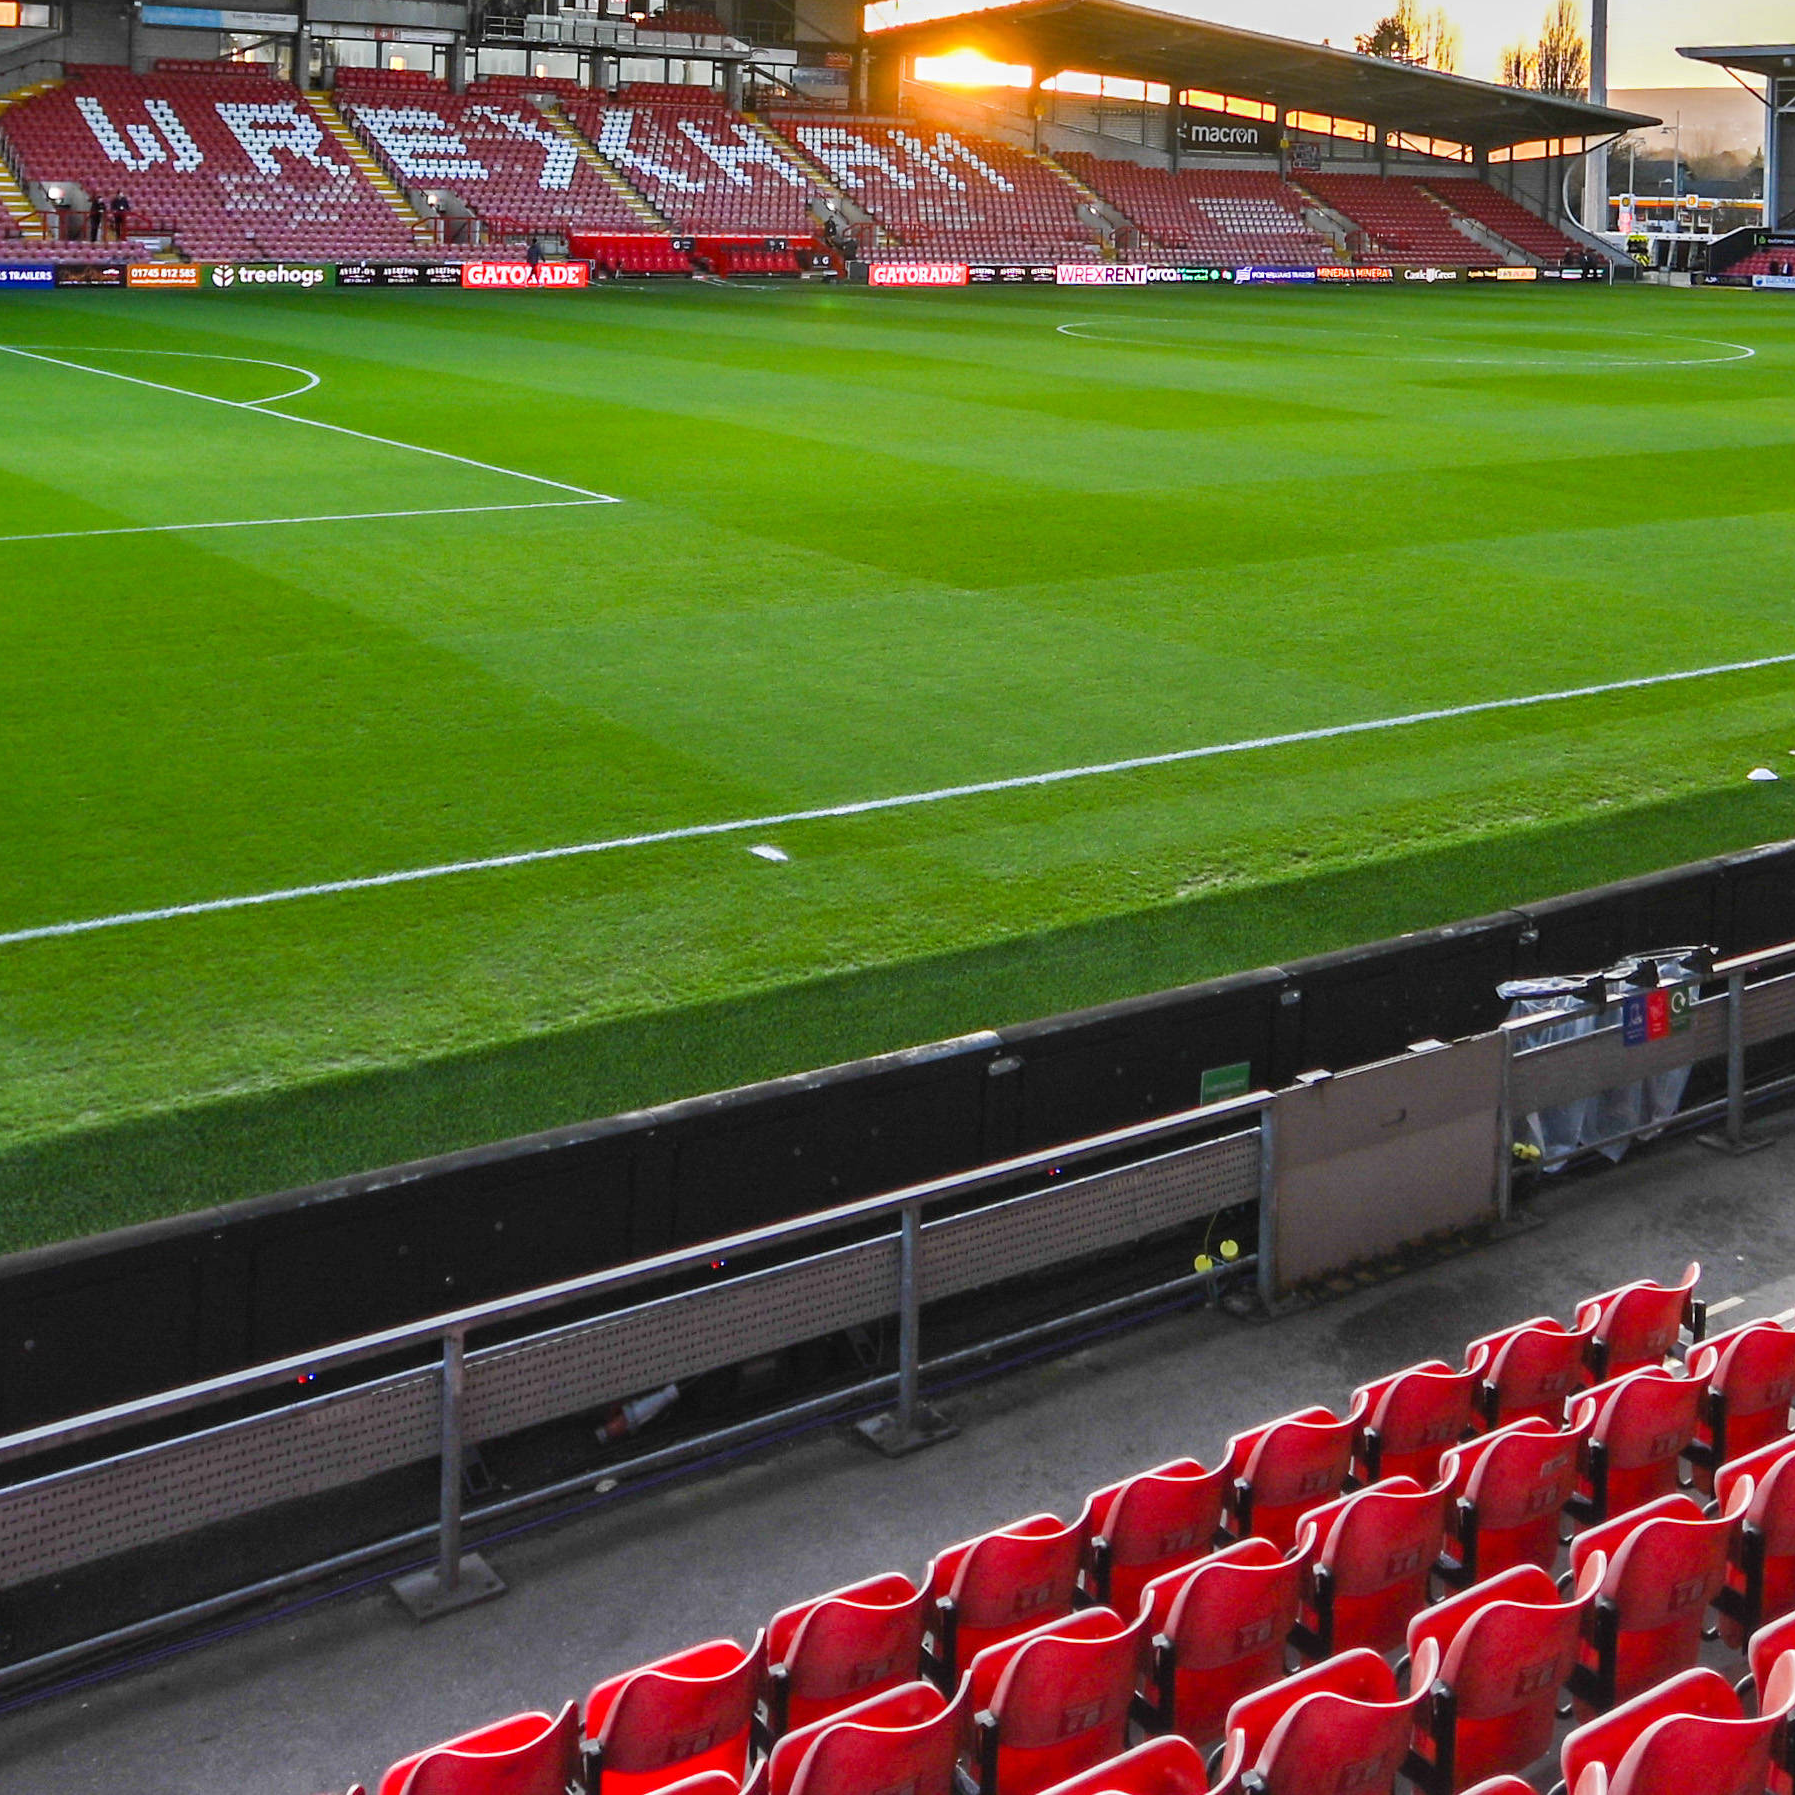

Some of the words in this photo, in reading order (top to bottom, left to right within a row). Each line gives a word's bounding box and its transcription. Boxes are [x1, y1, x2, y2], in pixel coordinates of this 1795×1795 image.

[1191, 125, 1258, 145] macron
[9, 270, 53, 281] TRAILERS
[238, 264, 324, 288] treehogs
[874, 266, 962, 283] GATORADE
[1147, 268, 1177, 282] orca
